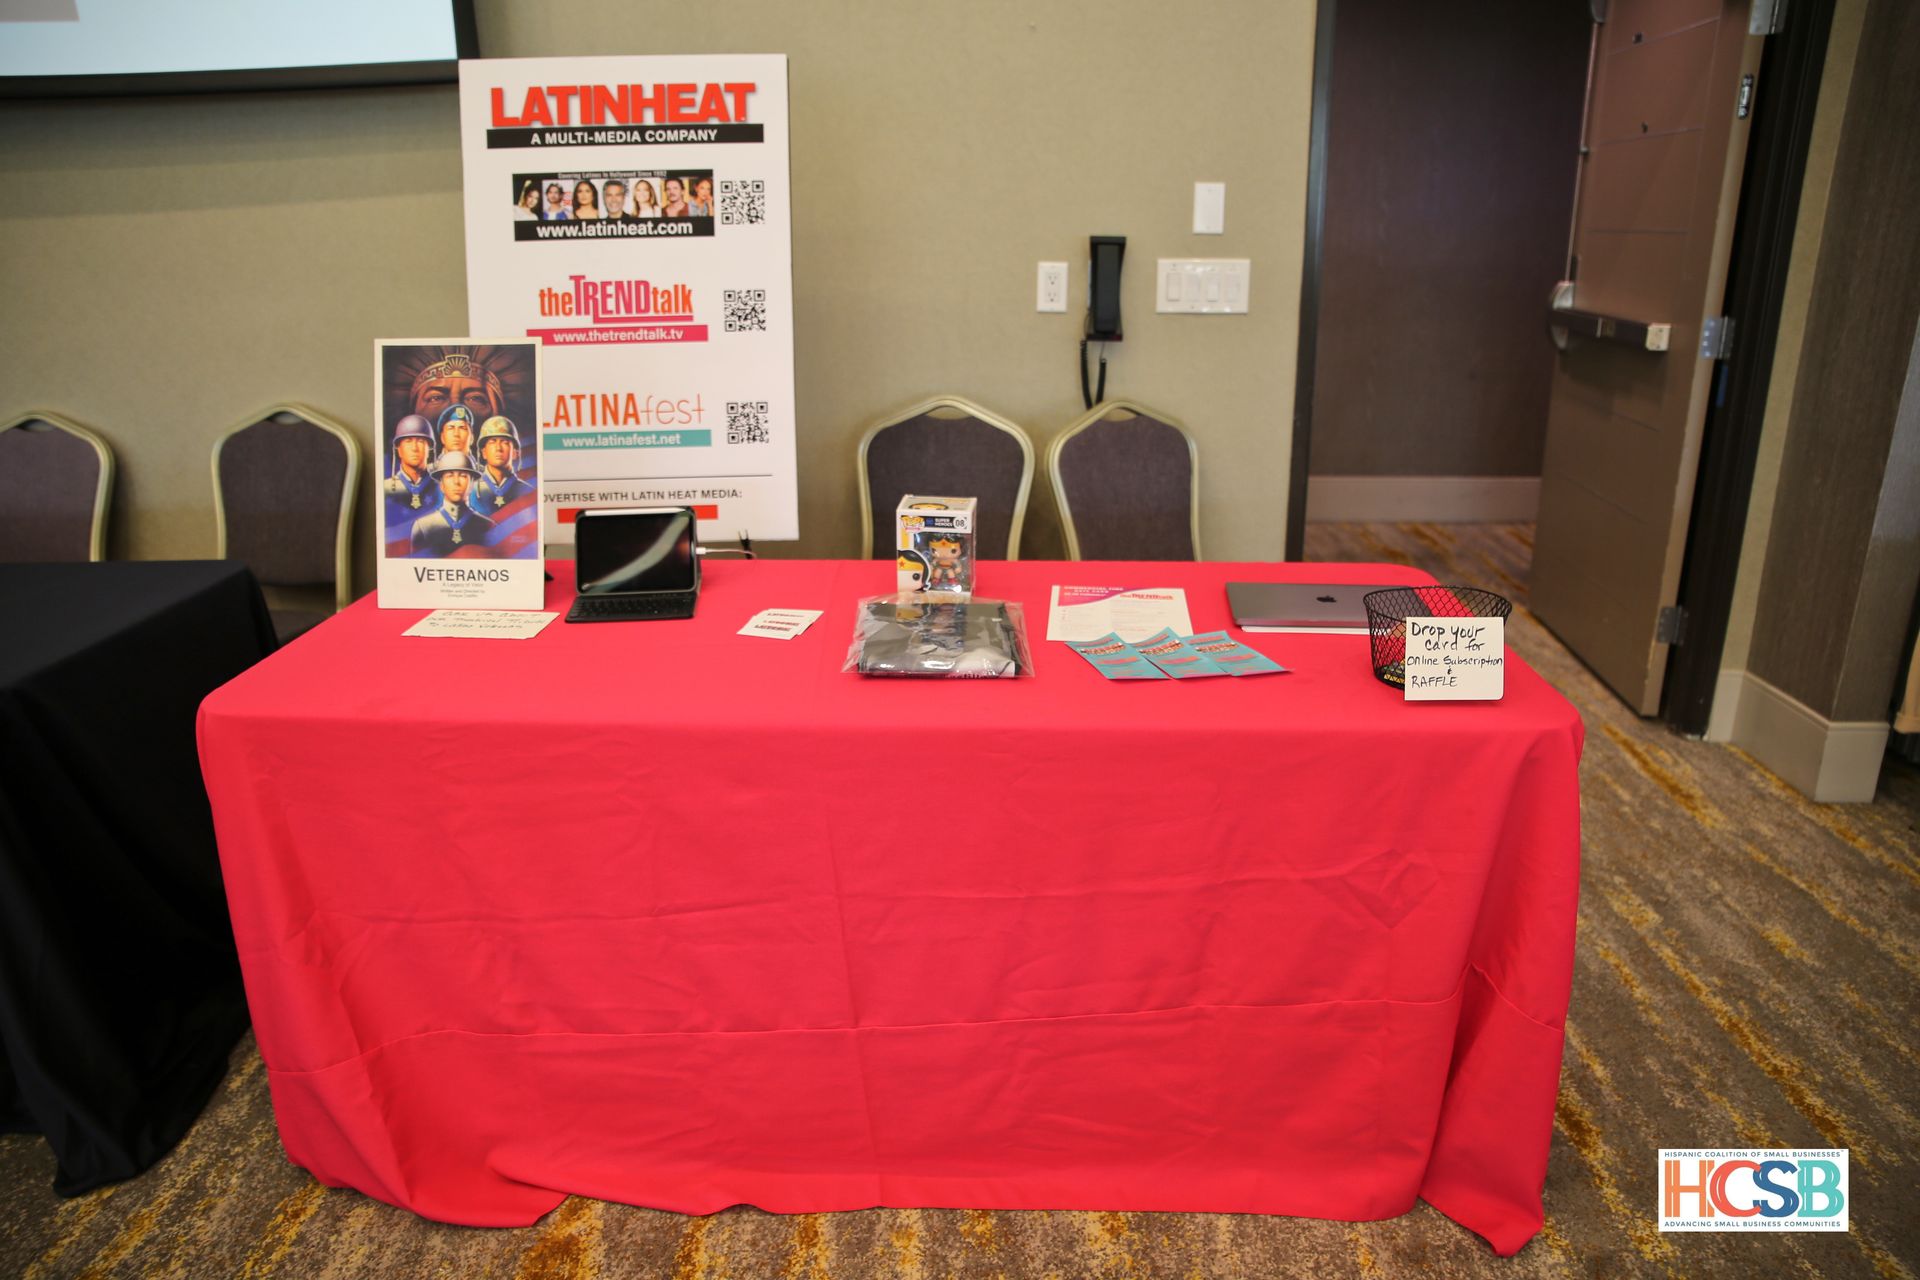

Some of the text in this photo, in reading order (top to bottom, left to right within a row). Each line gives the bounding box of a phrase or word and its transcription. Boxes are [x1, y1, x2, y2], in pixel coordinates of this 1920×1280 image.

[491, 82, 756, 127] LATINHEAT
[530, 129, 718, 146] A MULTI-MEDIA COMPANY
[537, 220, 693, 238] www.latinheat.com
[553, 328, 684, 343] www.thetrendtalk.tv
[562, 432, 681, 448] www.latinafest.net
[598, 492, 629, 501] WITH
[632, 491, 665, 500] LATIN
[668, 490, 698, 500] HEAT
[701, 488, 743, 498] MEDIA:
[955, 519, 965, 527] 08
[1411, 622, 1486, 641] Drop your
[1465, 638, 1486, 651] for
[1443, 655, 1503, 668] Subscription
[1411, 675, 1458, 688] RAFFLE
